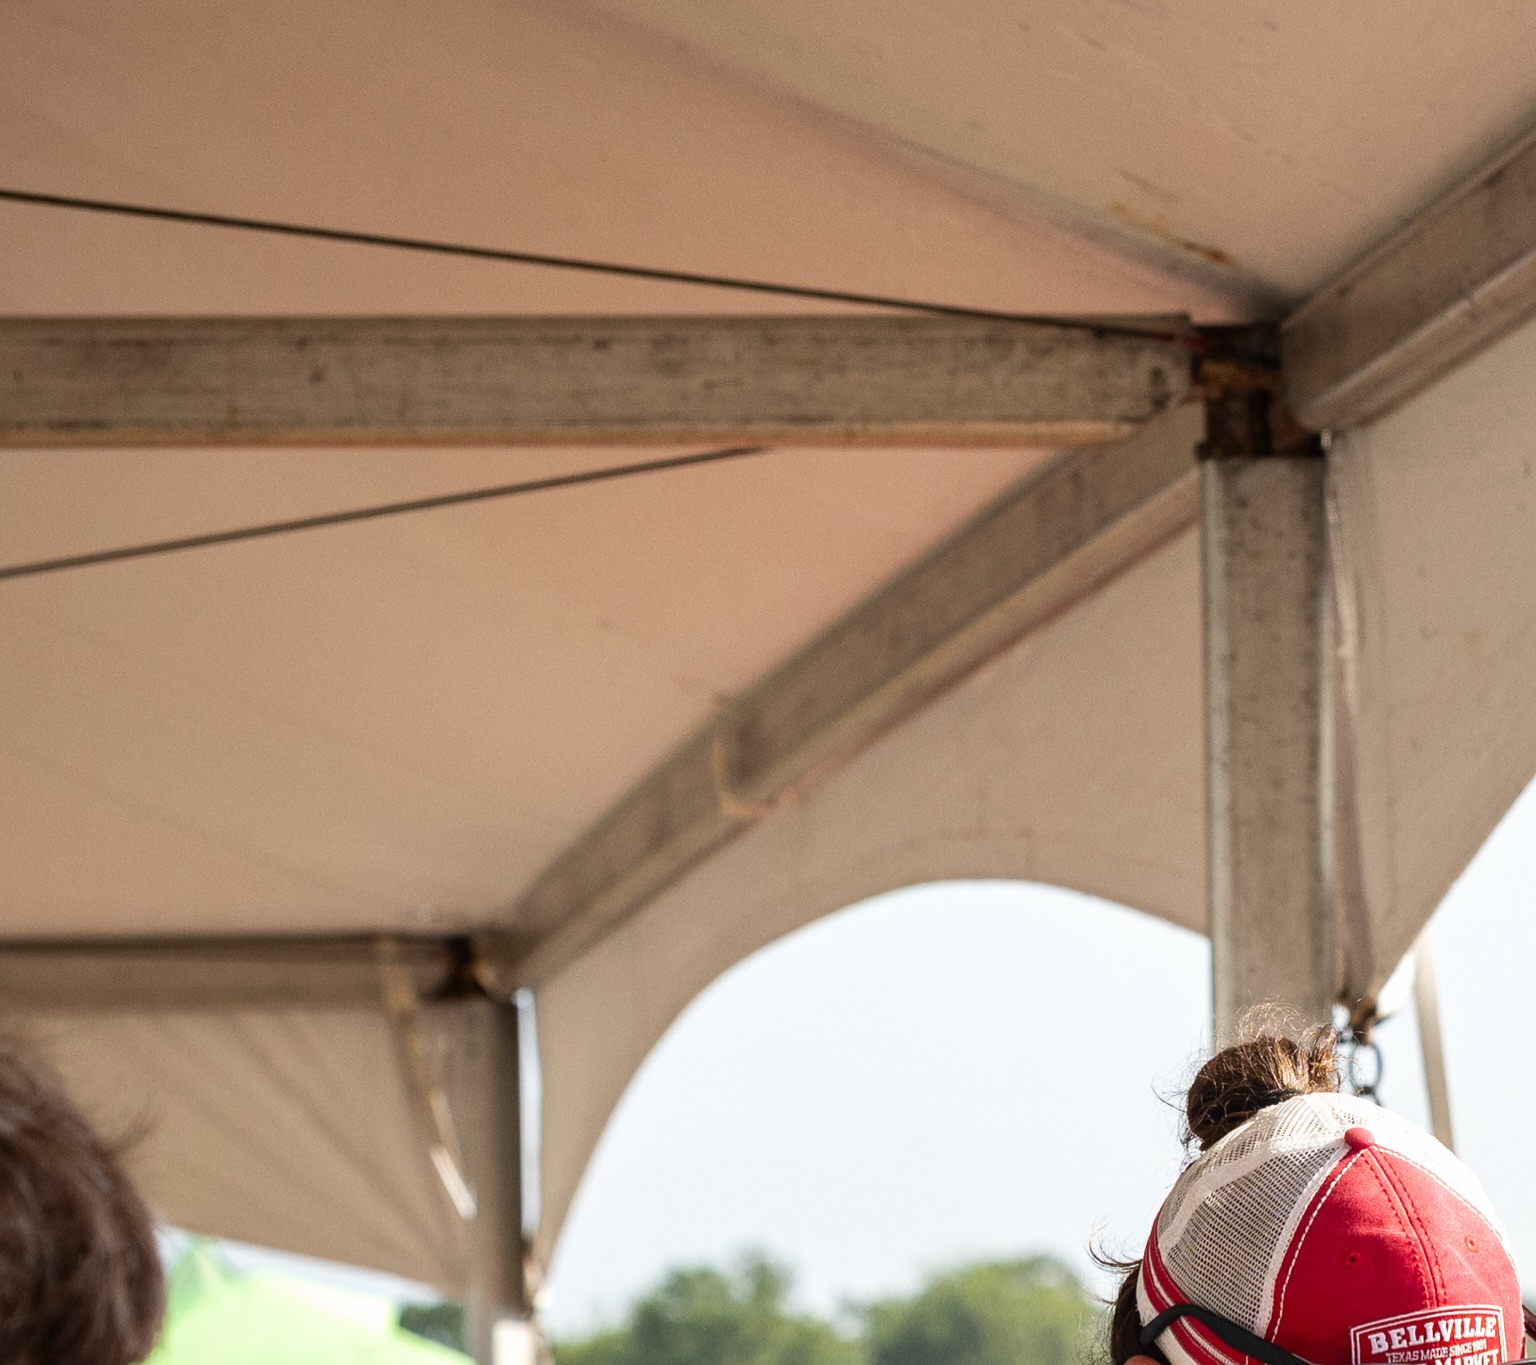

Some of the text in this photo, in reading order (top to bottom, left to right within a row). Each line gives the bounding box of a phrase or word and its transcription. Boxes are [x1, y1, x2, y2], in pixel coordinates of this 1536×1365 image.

[1368, 1317, 1497, 1355] BELLVILLE
[1386, 1349, 1420, 1363] TEXAS
[1420, 1346, 1449, 1362] MADE
[1449, 1342, 1473, 1357] SINCE
